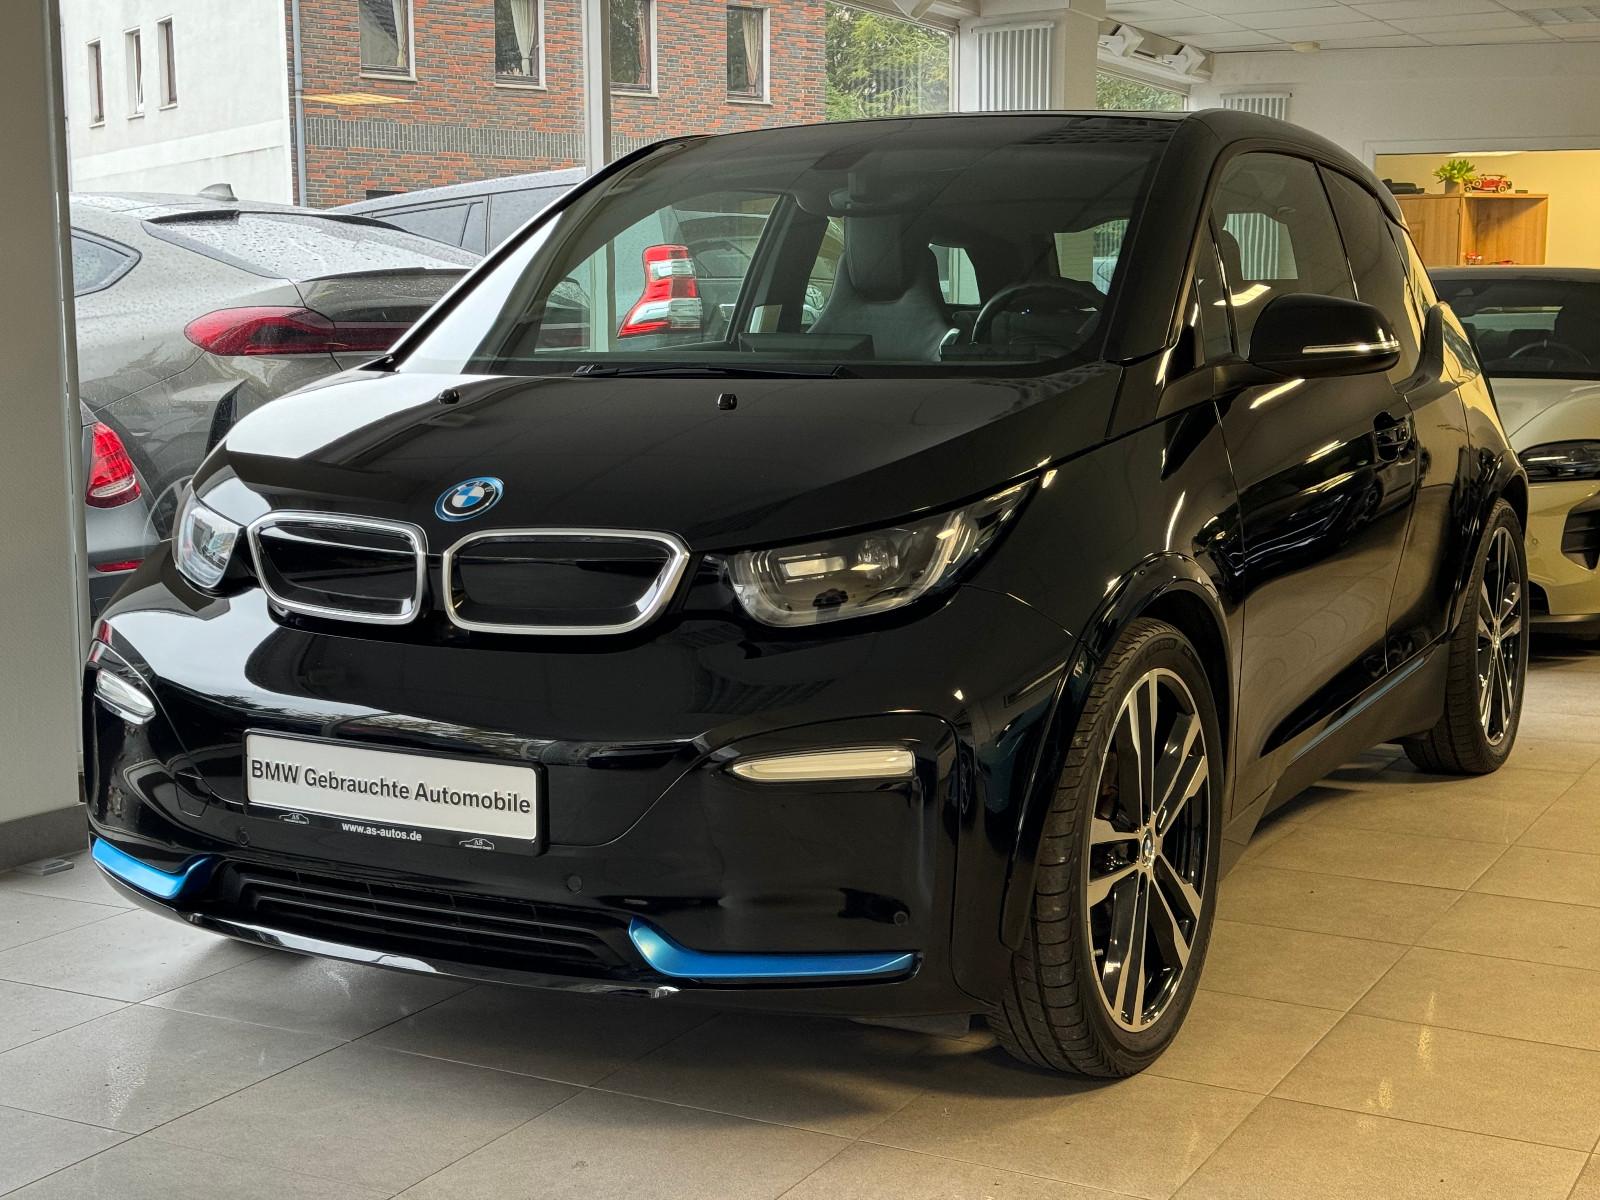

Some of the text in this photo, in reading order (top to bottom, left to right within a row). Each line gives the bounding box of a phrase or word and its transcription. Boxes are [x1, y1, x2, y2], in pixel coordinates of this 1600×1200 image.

[251, 758, 532, 814] BMW Gebrauchte Automobile
[341, 822, 423, 842] www.as-autos.de
